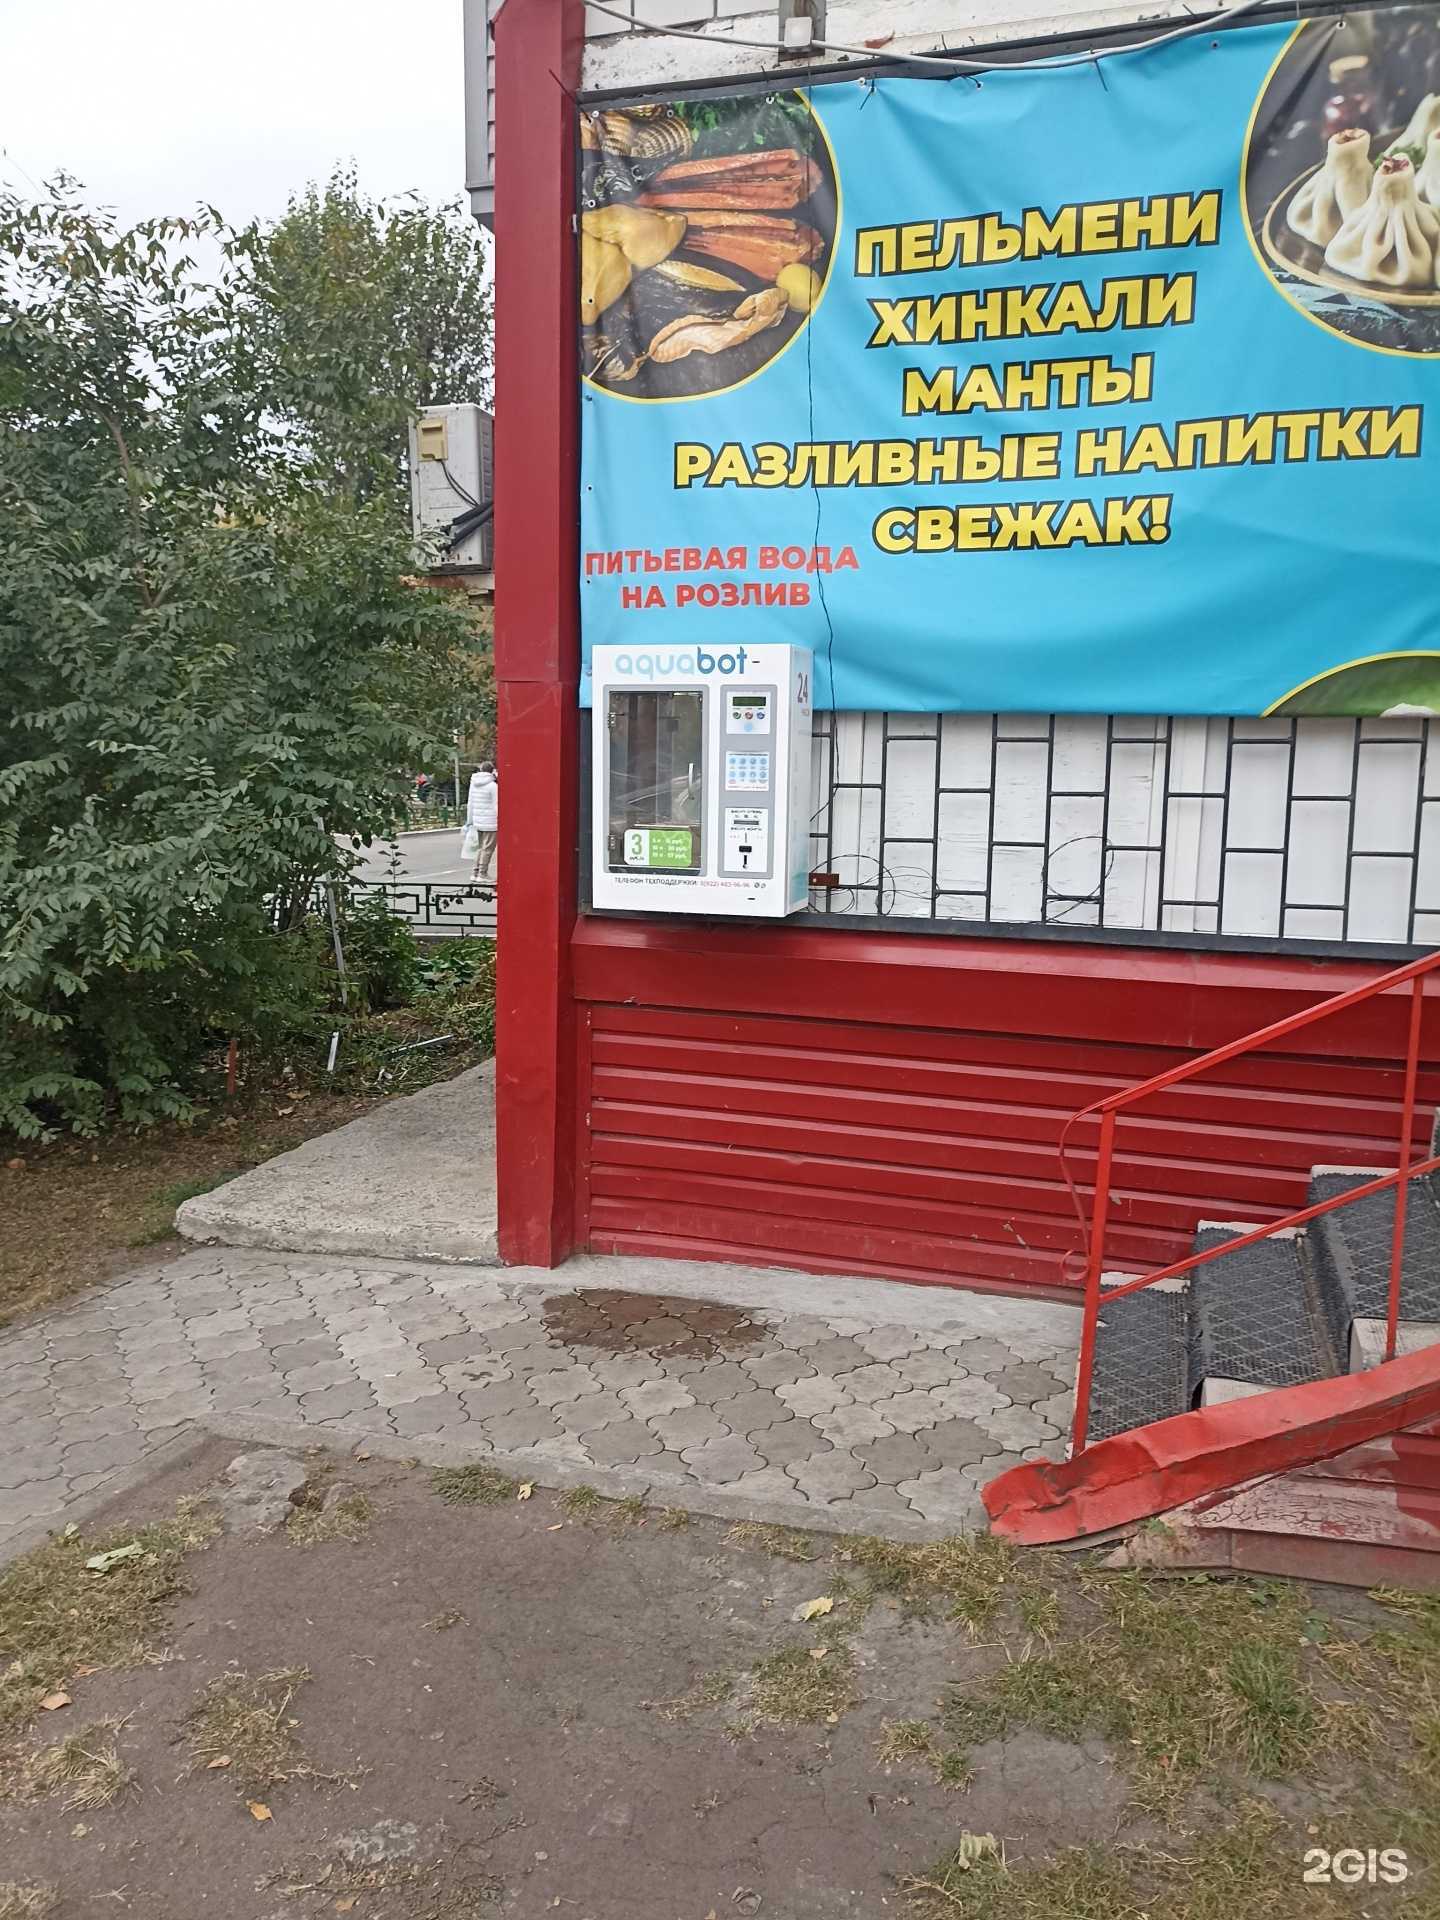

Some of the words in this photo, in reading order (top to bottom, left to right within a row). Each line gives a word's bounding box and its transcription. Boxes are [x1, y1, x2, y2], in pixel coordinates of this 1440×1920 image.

[855, 190, 1223, 279] ПЕЛЬМЕНИ
[866, 272, 1197, 348] ХИНКАЛИ
[902, 353, 1155, 416] МАНТЫ
[674, 431, 1062, 489] РАЗЛИВНЫЕ
[1076, 406, 1423, 477] НАПИТКИ
[873, 495, 1173, 554] СВЕЖАК!
[585, 546, 747, 575] ПИТЬЕВАЯ
[759, 546, 860, 574] ВОДА
[621, 586, 666, 609] НА
[676, 583, 811, 607] РОЗЛИВ
[615, 646, 748, 680] aquabot
[797, 672, 808, 704] 24
[631, 833, 642, 855] 3
[614, 877, 644, 885] ТЕЛЕФОН
